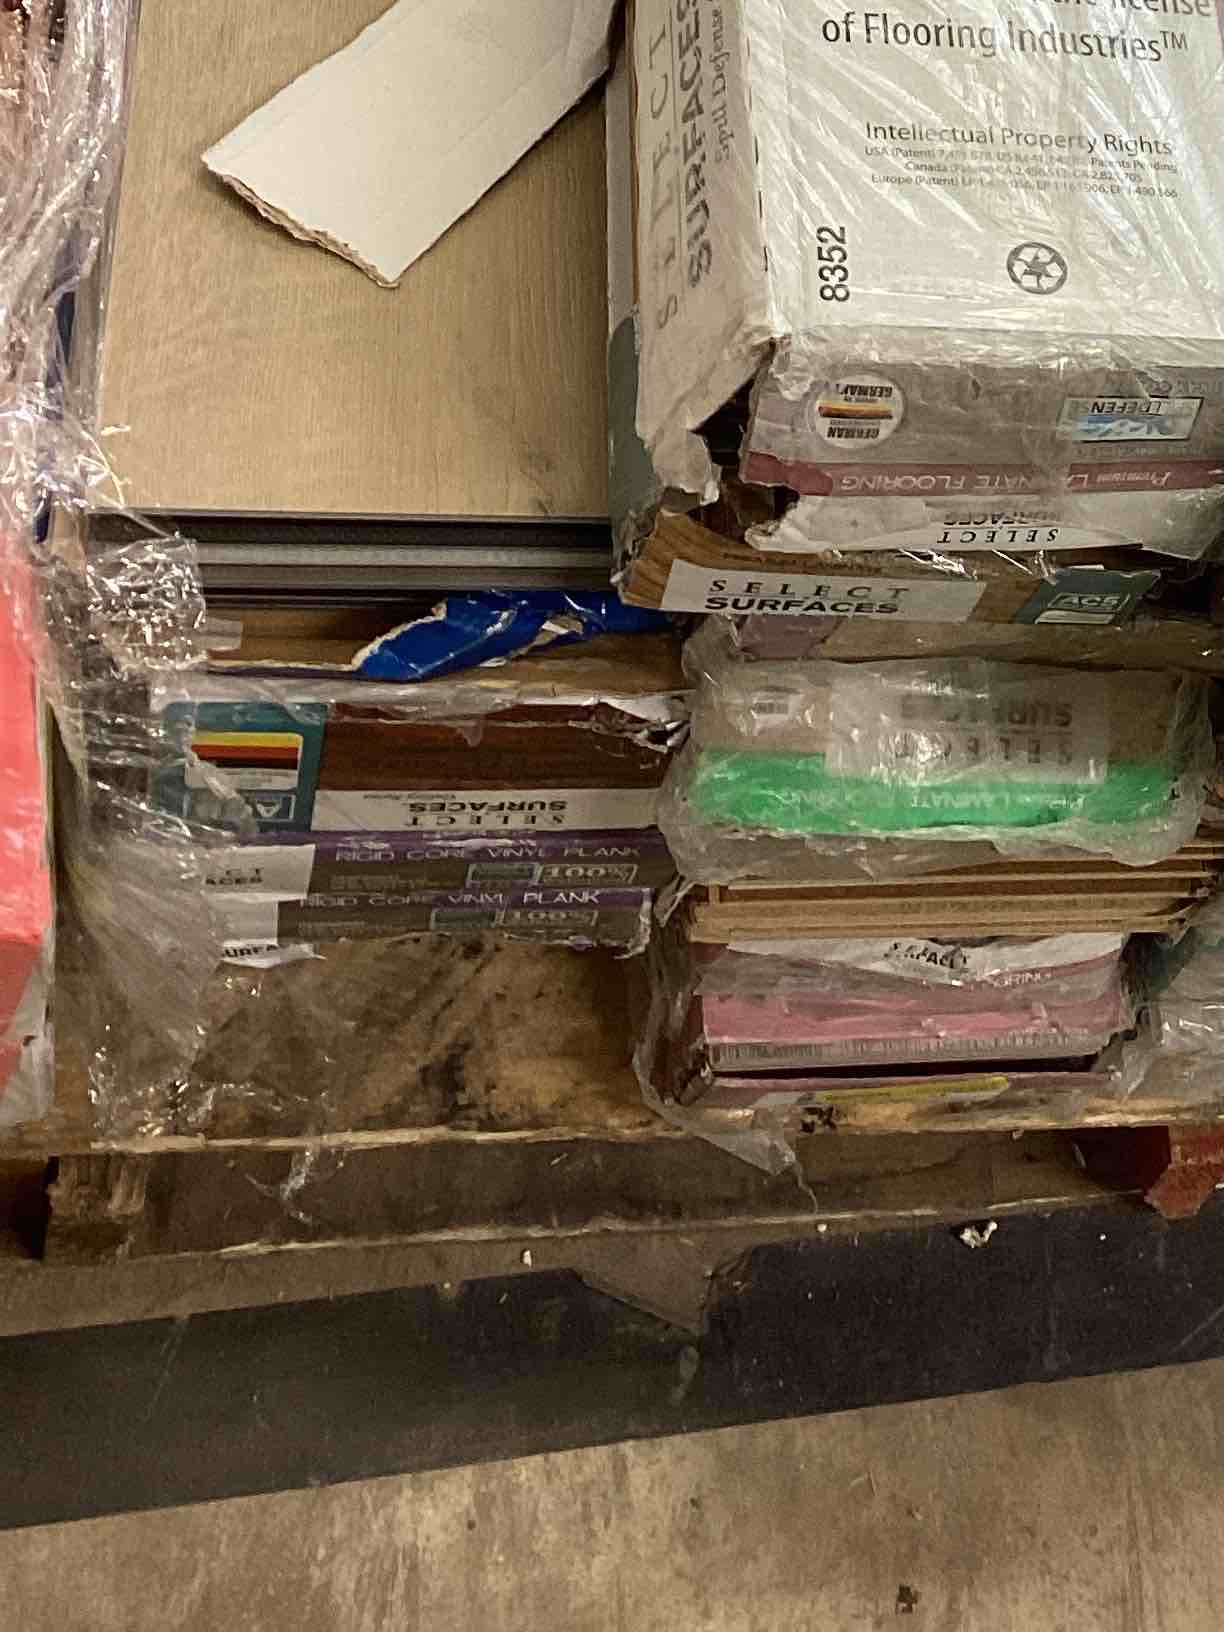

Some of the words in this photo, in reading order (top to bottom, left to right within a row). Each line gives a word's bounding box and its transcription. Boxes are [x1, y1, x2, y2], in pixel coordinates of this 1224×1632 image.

[821, 11, 855, 44] of
[863, 12, 996, 58] Flooring
[706, 8, 733, 100] Defense
[713, 104, 737, 167] Spill
[865, 121, 995, 146] Intellectual
[1001, 127, 1098, 153] Property
[1103, 132, 1175, 157] Rights
[816, 224, 850, 304] 8352
[839, 472, 968, 494] FLOORING
[935, 527, 1060, 545] SELECT
[708, 579, 910, 600] SELECT
[704, 596, 900, 615] SURFACES
[407, 799, 568, 813] SURFACES
[405, 814, 565, 828] SELECT
[335, 846, 396, 862] RIGID
[487, 846, 547, 860] VINYL
[562, 845, 641, 859] PLANK
[522, 890, 600, 905] PLANK
